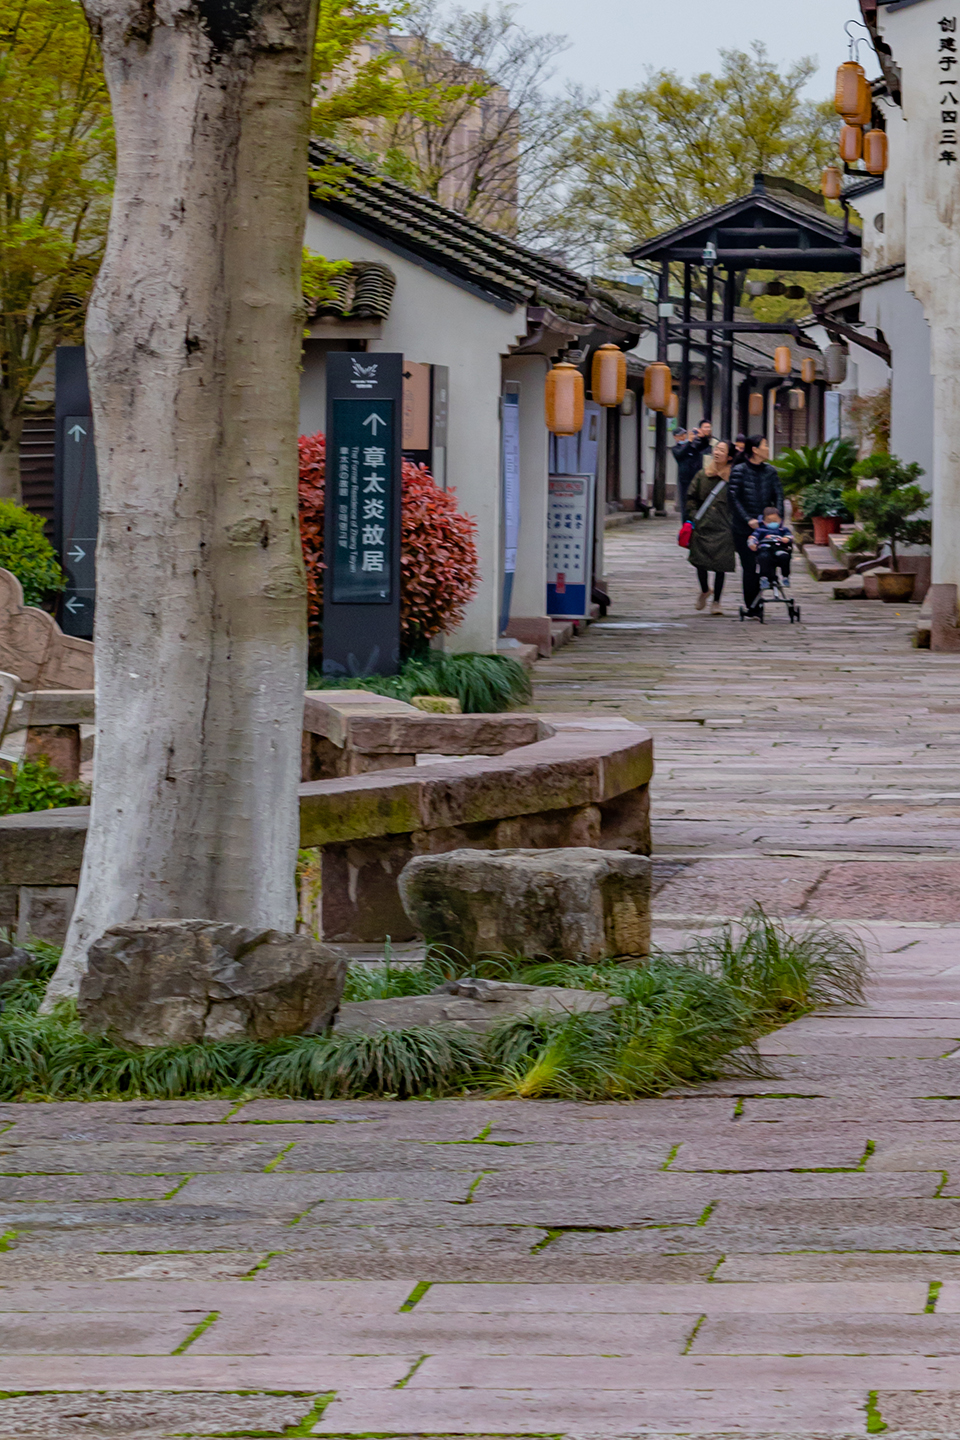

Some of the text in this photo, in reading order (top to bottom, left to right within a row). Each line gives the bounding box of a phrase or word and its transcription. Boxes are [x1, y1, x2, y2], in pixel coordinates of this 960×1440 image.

[937, 16, 959, 166] 创建于一八四三年
[350, 446, 360, 459] The
[362, 446, 386, 572] 章太炎故居
